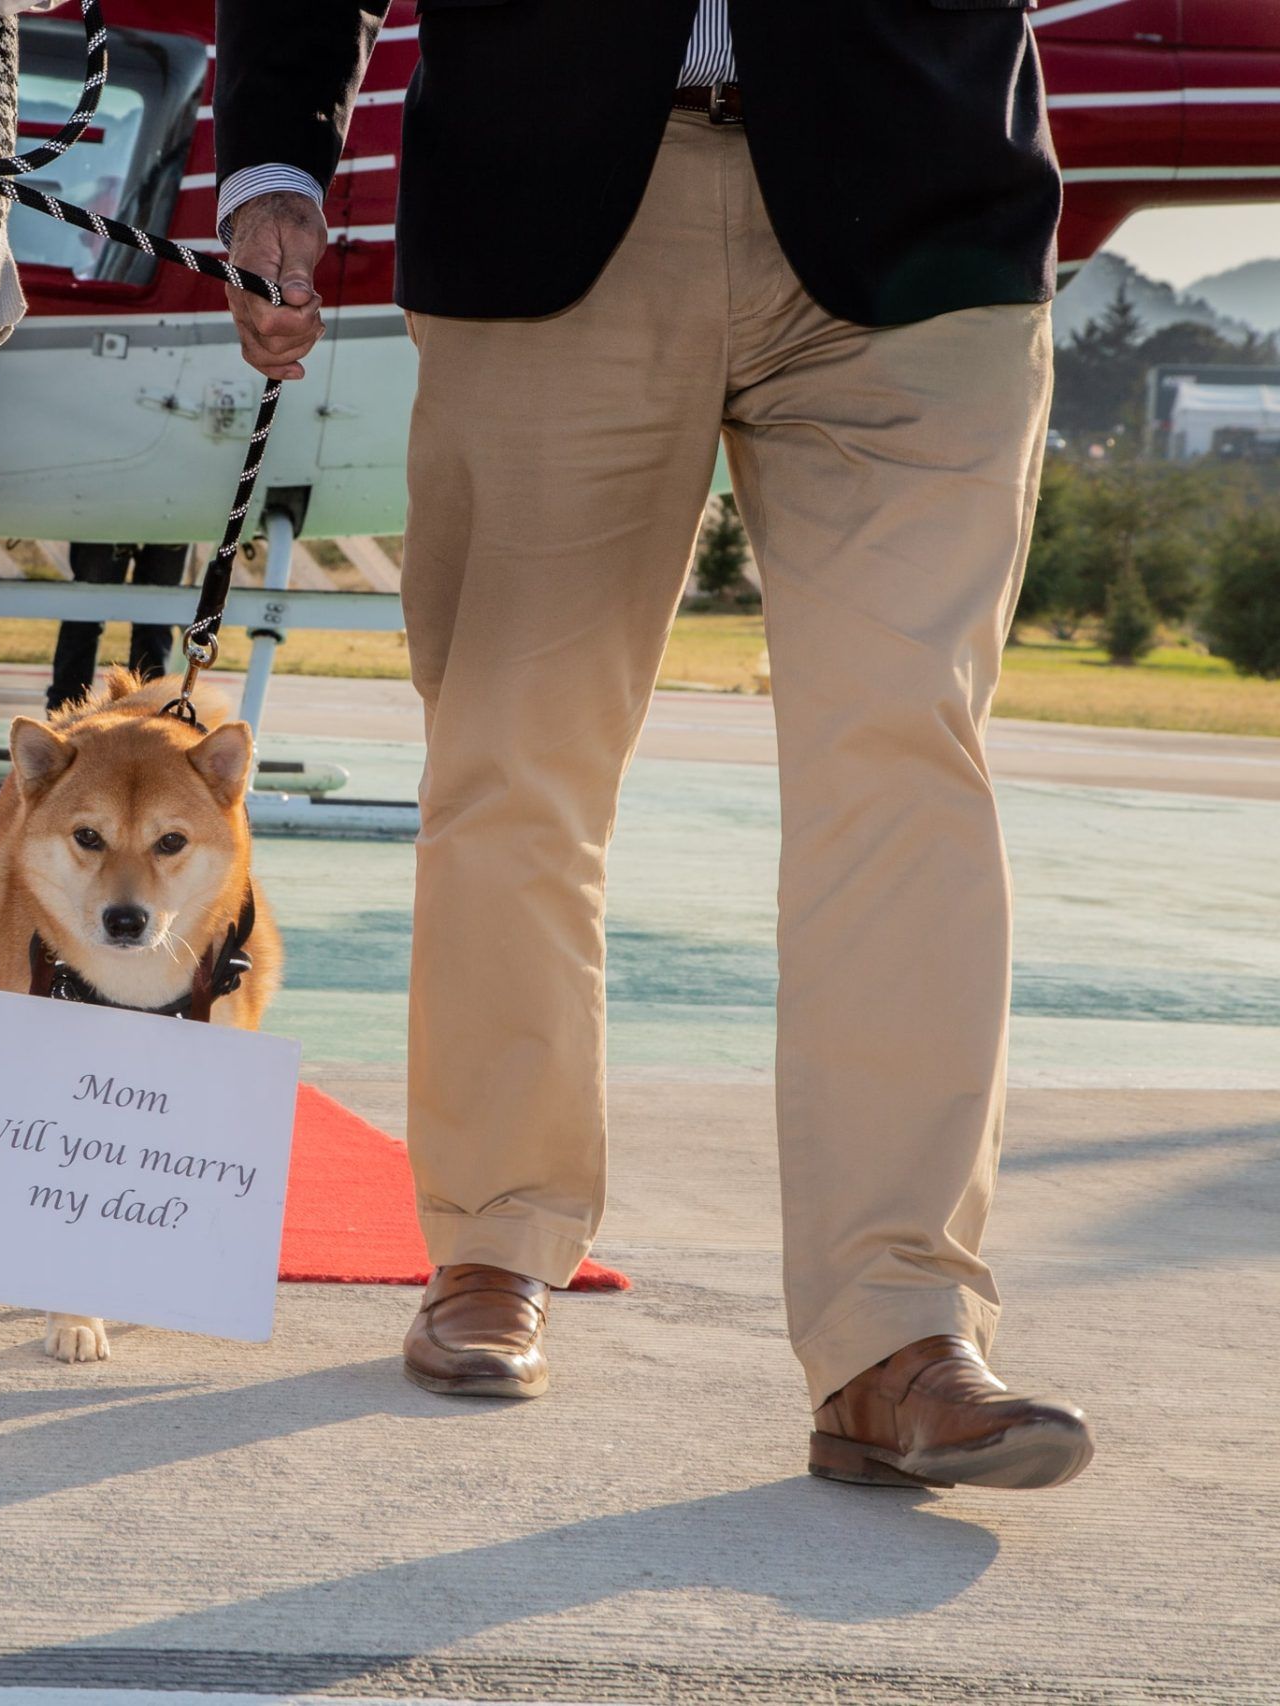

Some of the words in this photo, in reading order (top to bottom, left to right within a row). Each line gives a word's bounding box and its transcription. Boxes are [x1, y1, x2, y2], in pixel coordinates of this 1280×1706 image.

[72, 1074, 170, 1115] Mom
[58, 1134, 128, 1168] you
[139, 1147, 258, 1198] marry
[28, 1184, 89, 1225] my
[100, 1189, 189, 1229] dad?
